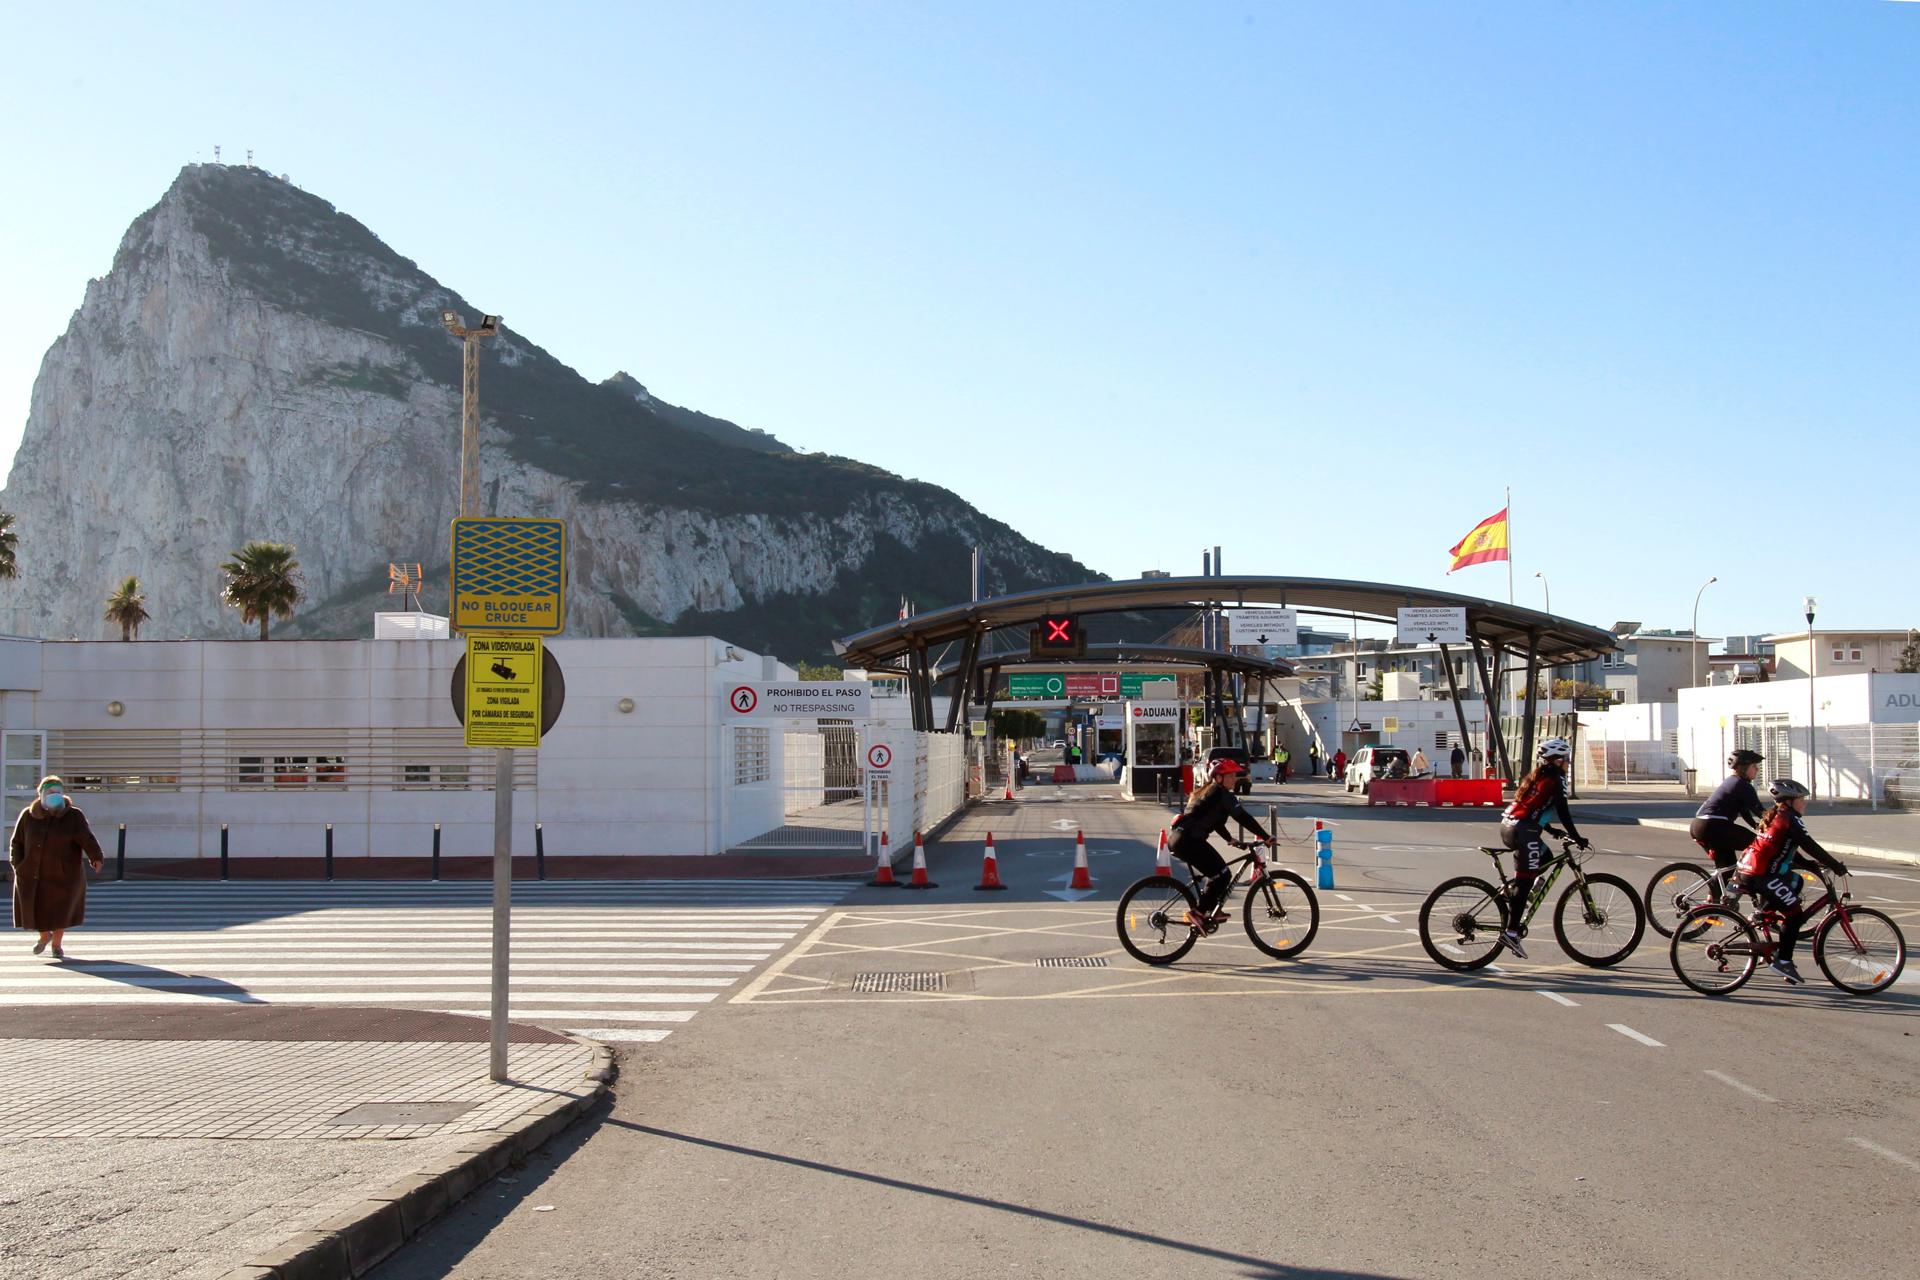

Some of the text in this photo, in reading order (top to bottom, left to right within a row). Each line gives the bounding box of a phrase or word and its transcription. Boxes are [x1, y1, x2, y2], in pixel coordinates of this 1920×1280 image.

[461, 601, 551, 612] NO BLOQUEAR
[485, 613, 528, 623] CRUCE
[473, 641, 536, 652] ZONA VIDEOVIGILADA
[767, 688, 862, 697] PROHIBIDO EL PASO
[486, 697, 520, 705] ZONA VIGILADA
[773, 704, 855, 713] NO TRESPASSING
[1143, 707, 1178, 717] ADUANA
[472, 709, 534, 719] POR CÁMARAS DE SEGURIDAD
[1527, 841, 1540, 870] UCM
[1767, 878, 1797, 906] UCM
